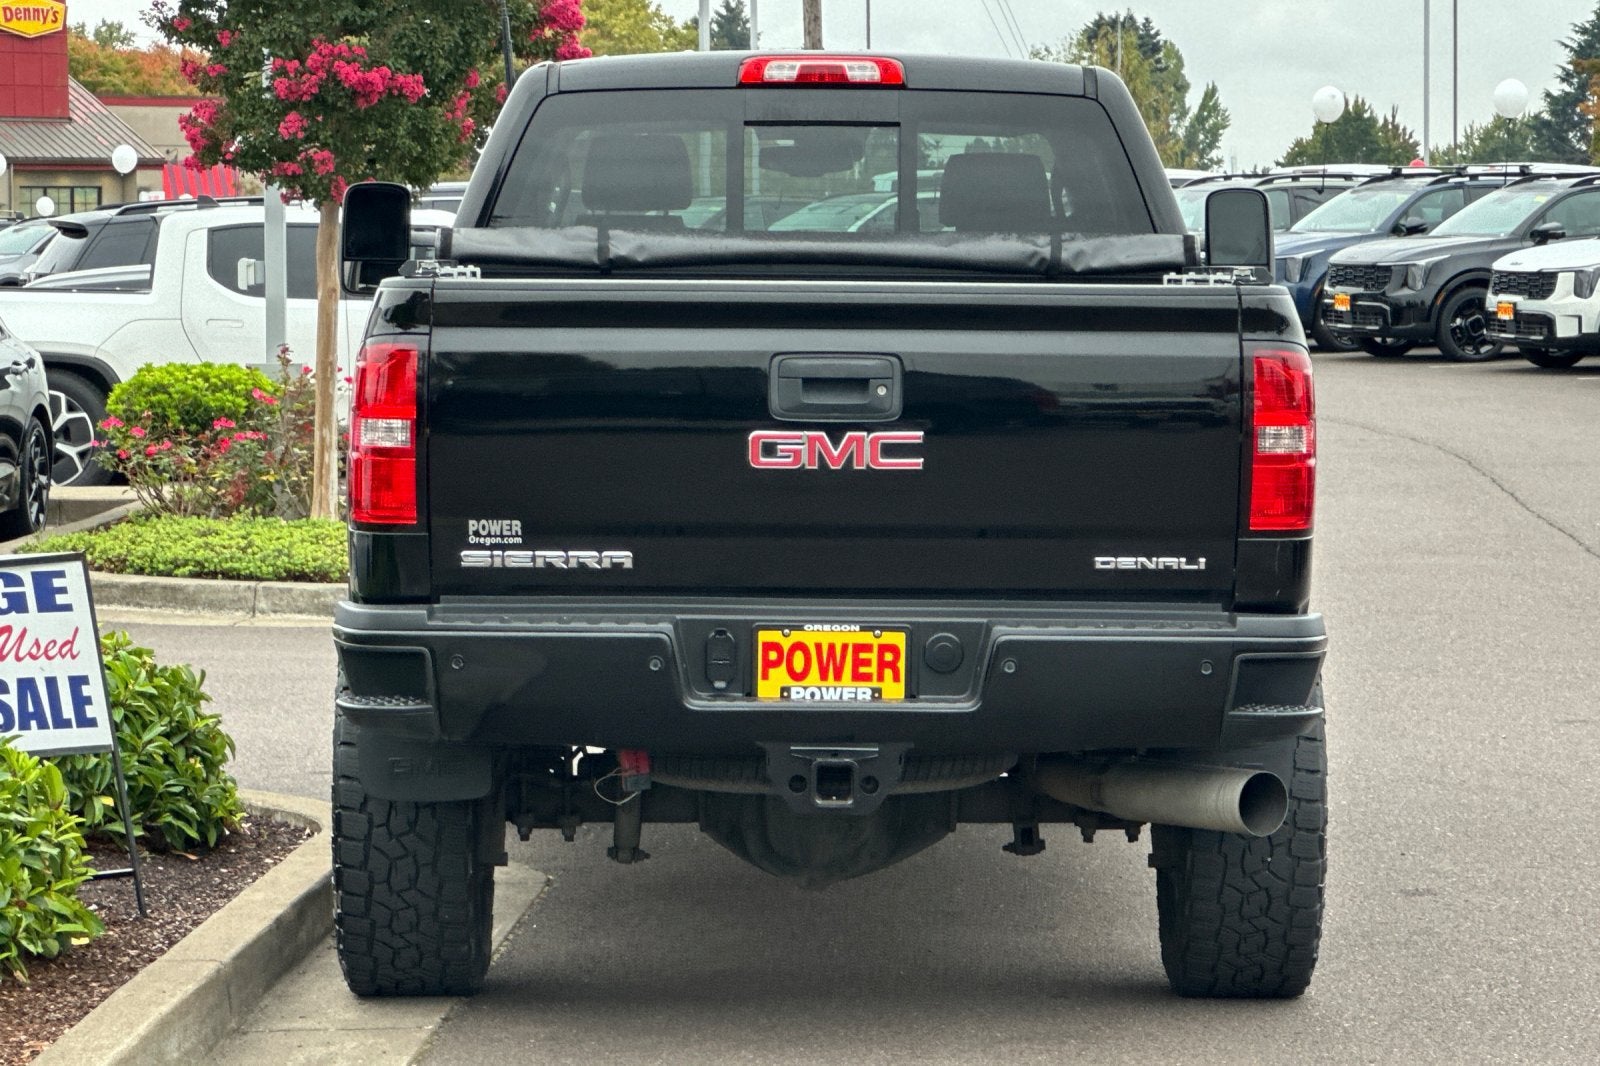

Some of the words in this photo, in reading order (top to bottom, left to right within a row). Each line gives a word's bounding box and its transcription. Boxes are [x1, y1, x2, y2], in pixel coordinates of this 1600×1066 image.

[2, 6, 60, 24] Denny's
[748, 430, 924, 470] GMC
[468, 519, 522, 536] POWER
[468, 535, 523, 546] Oregon.com
[460, 550, 634, 569] SIERRA
[1094, 556, 1207, 570] DENALI
[803, 624, 861, 632] OREGON
[0, 624, 80, 663] Used
[760, 640, 902, 683] POWER
[790, 686, 873, 700] POWER
